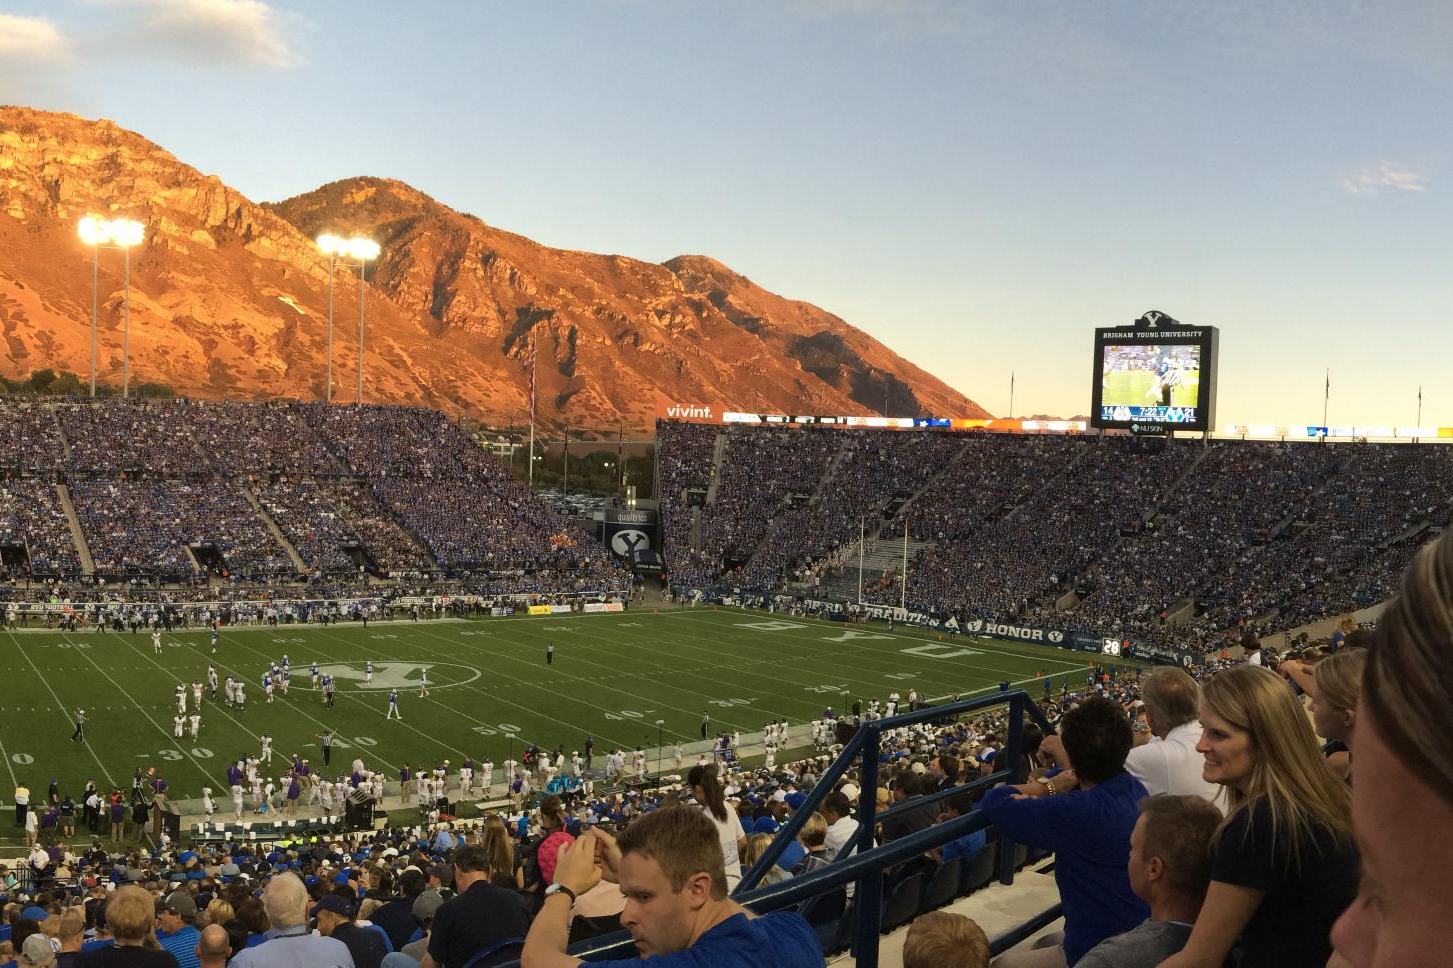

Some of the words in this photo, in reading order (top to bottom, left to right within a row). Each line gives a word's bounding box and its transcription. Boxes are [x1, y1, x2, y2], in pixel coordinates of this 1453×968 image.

[1103, 406, 1113, 415] 14
[1140, 407, 1157, 416] 7:22
[1184, 408, 1194, 416] 21
[986, 623, 1044, 640] HONOR
[1104, 640, 1119, 654] 28
[157, 747, 215, 762] 30
